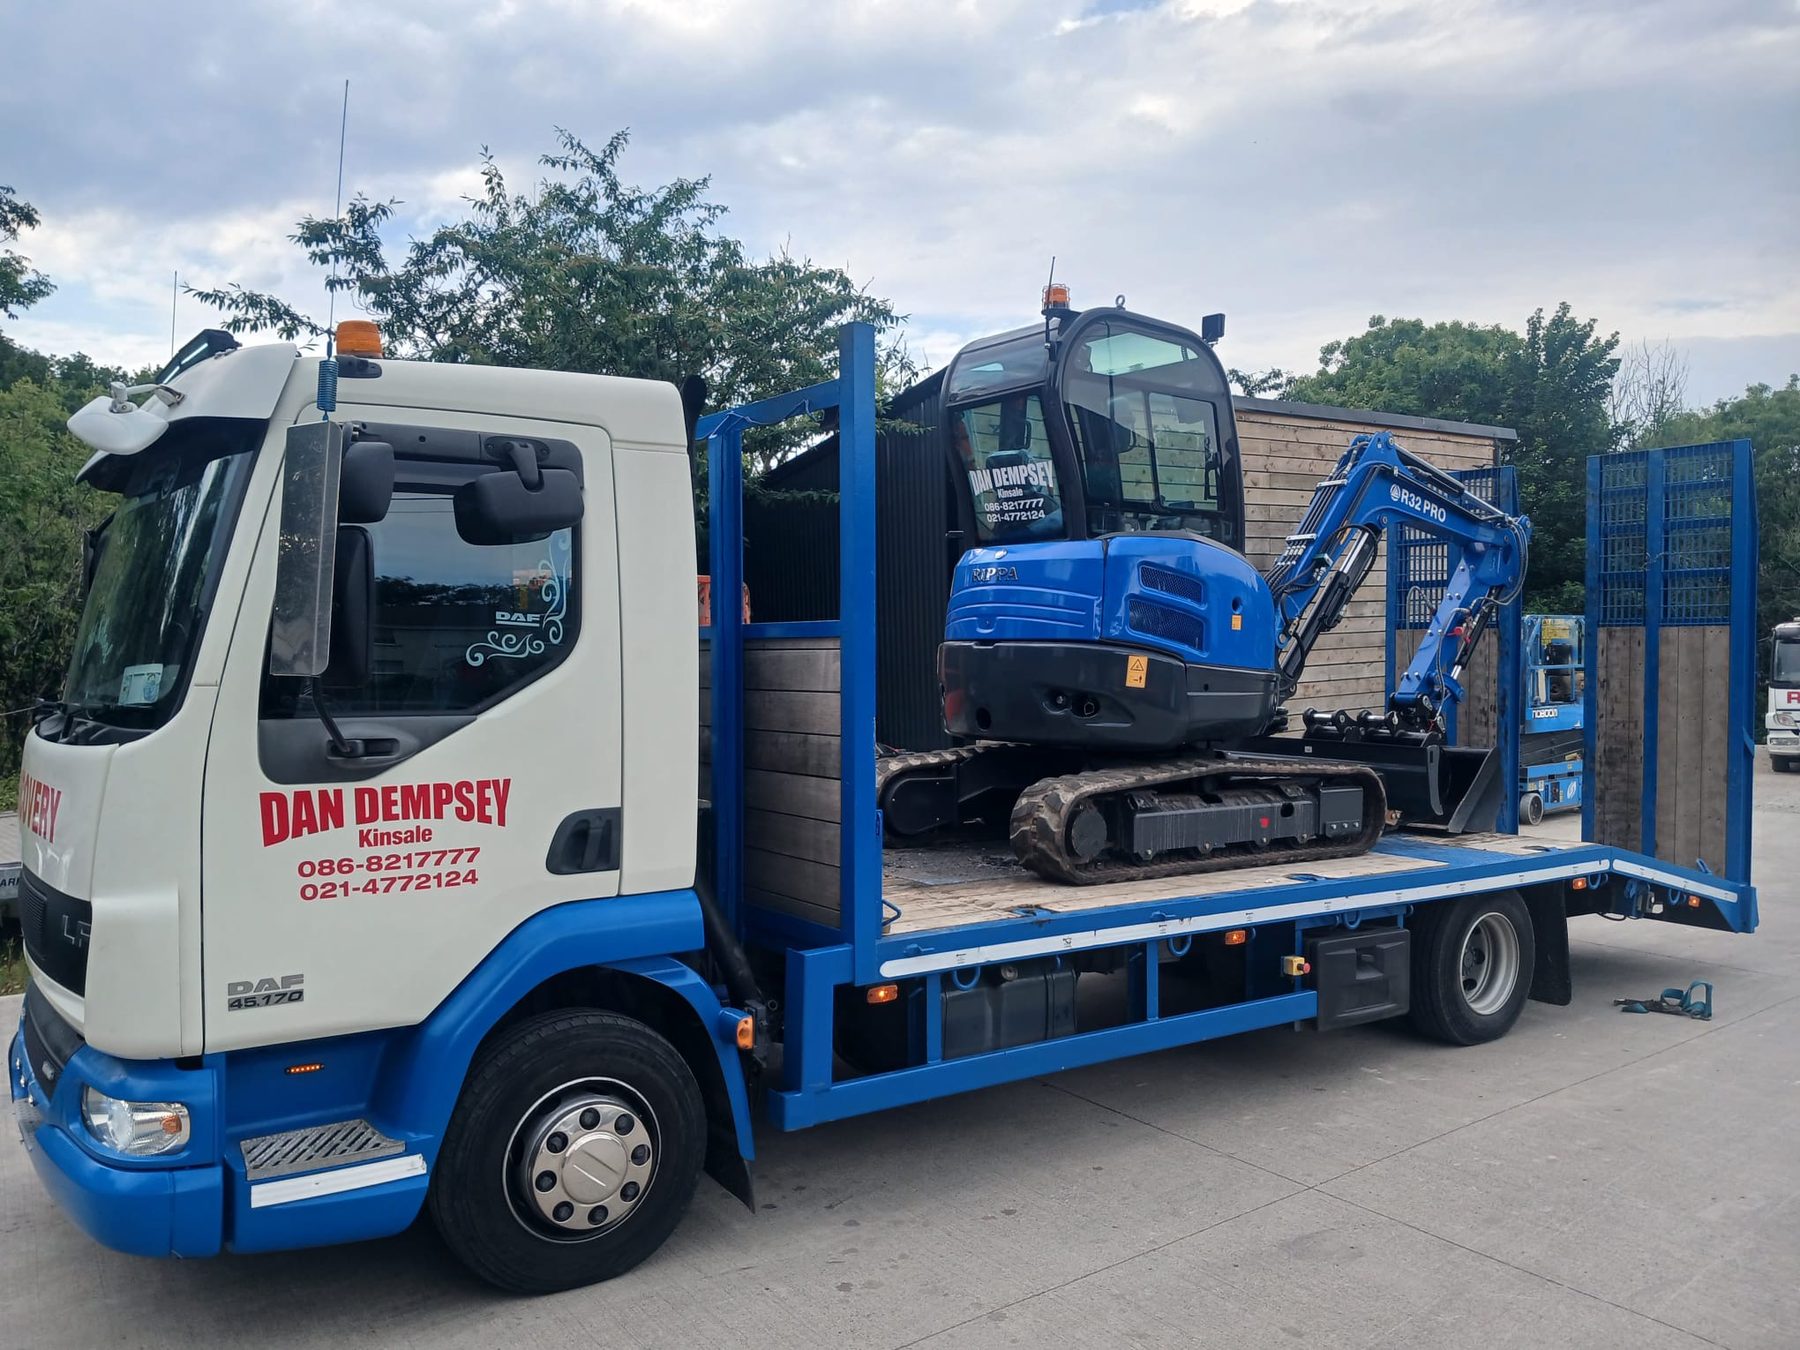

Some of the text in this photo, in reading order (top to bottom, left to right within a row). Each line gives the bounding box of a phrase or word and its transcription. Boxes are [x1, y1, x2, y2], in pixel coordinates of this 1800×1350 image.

[968, 459, 1054, 497] DAN DEMPSEY
[997, 487, 1023, 498] Kinsale
[984, 498, 1044, 512] 086-8217777
[986, 510, 1045, 522] 021-4772124
[1400, 488, 1446, 523] R32 PRO
[972, 566, 1018, 582] RIPPA
[496, 611, 540, 622] DAF
[259, 778, 511, 847] DAN DEMPSEY
[358, 825, 433, 848] Kinsale
[297, 847, 481, 878] 086-8217777
[299, 869, 479, 901] 021-4772124
[228, 974, 304, 996] DAF
[229, 990, 304, 1009] 45.170
